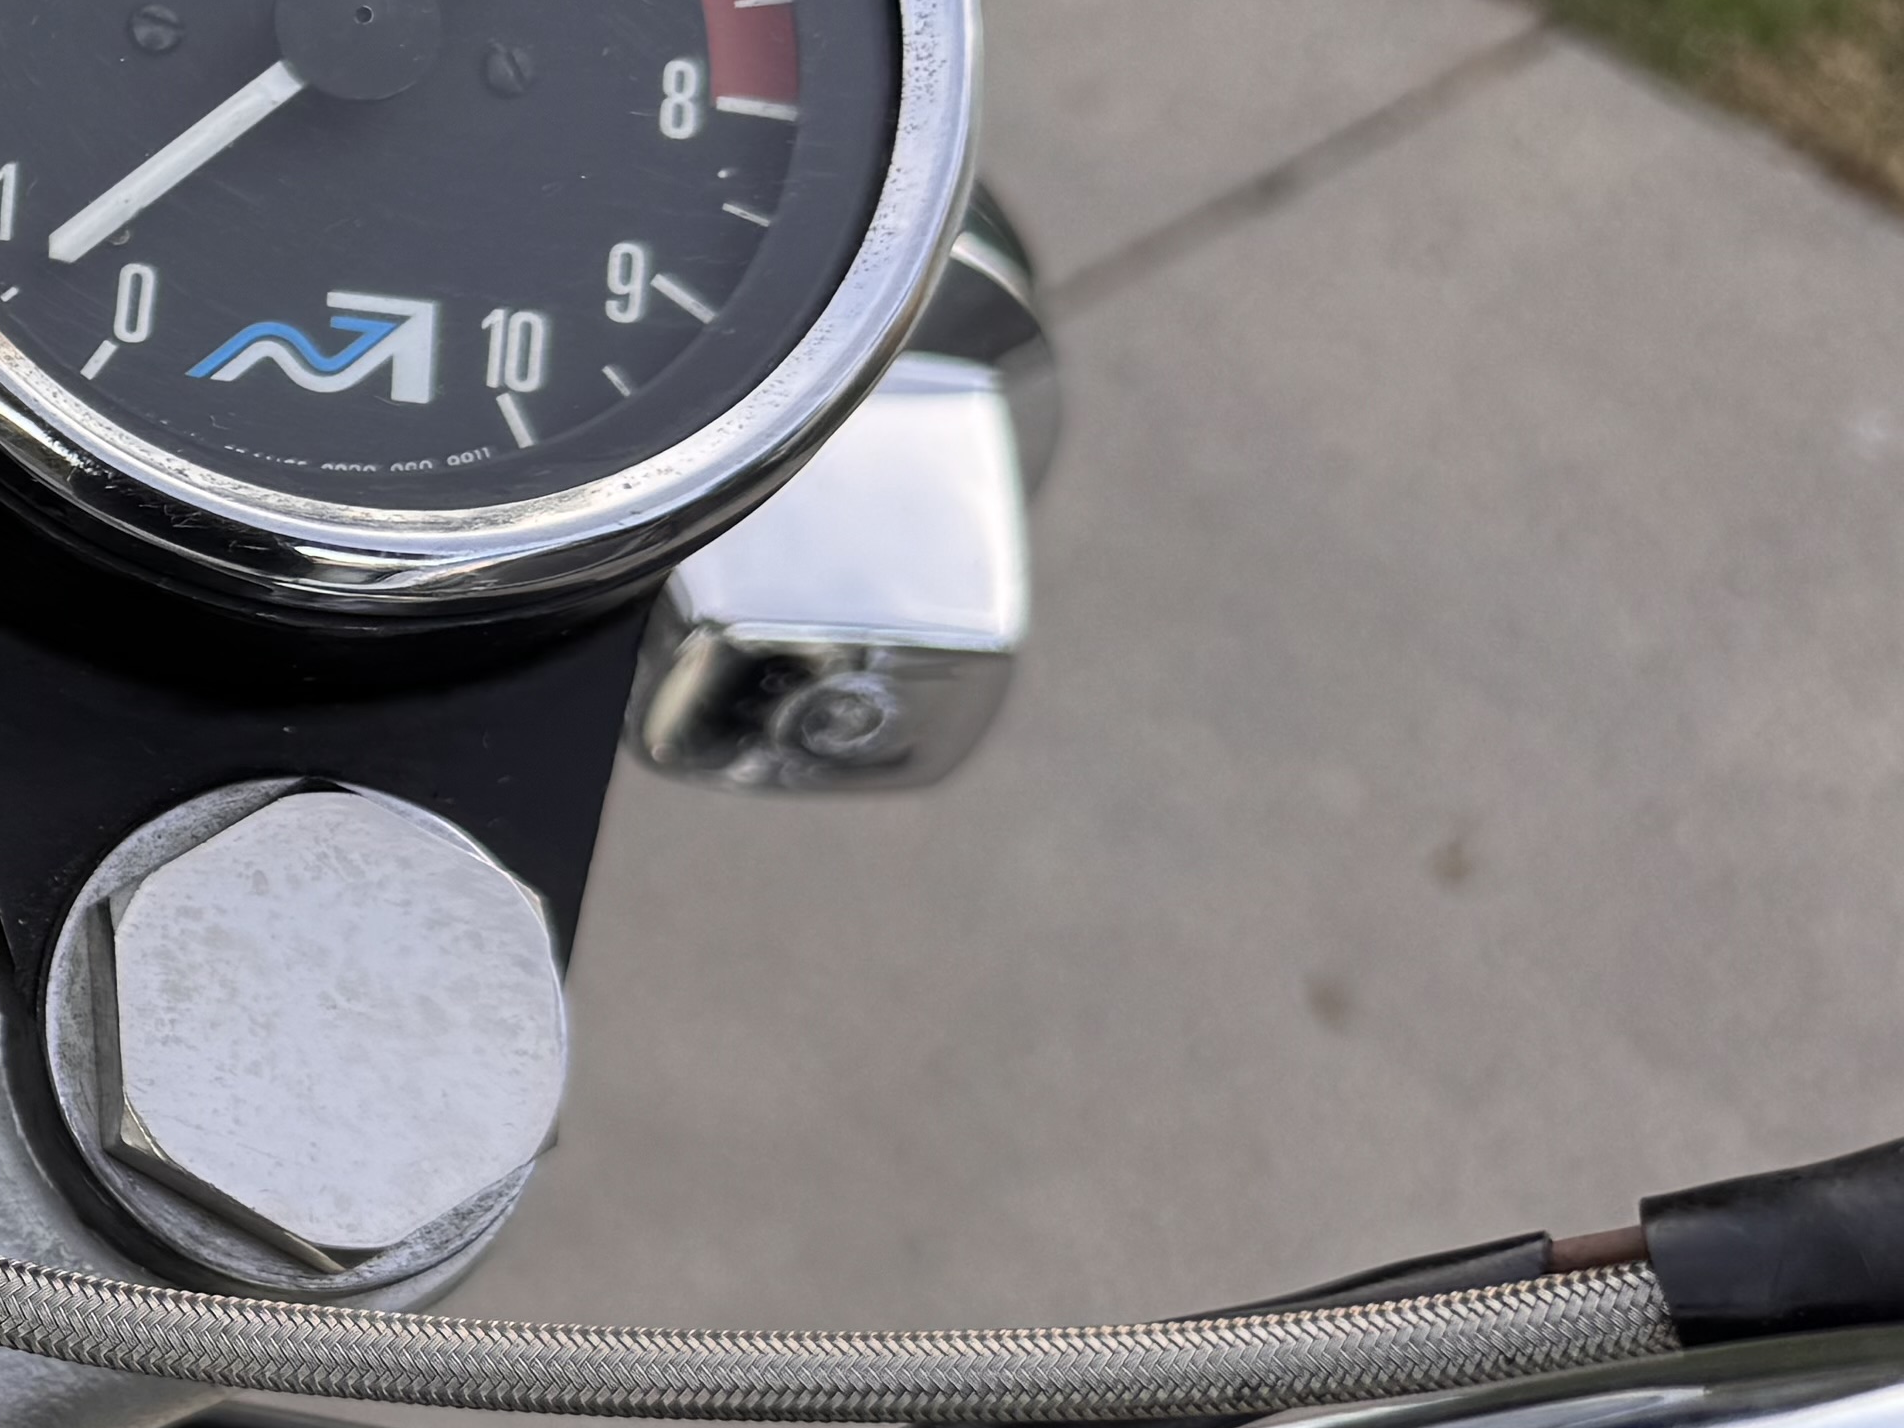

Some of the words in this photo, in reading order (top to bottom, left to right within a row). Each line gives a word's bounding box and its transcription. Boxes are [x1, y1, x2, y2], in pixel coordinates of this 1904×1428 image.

[659, 60, 698, 139] 8
[114, 263, 155, 343] 0
[605, 242, 643, 323] 9
[481, 308, 544, 392] 10
